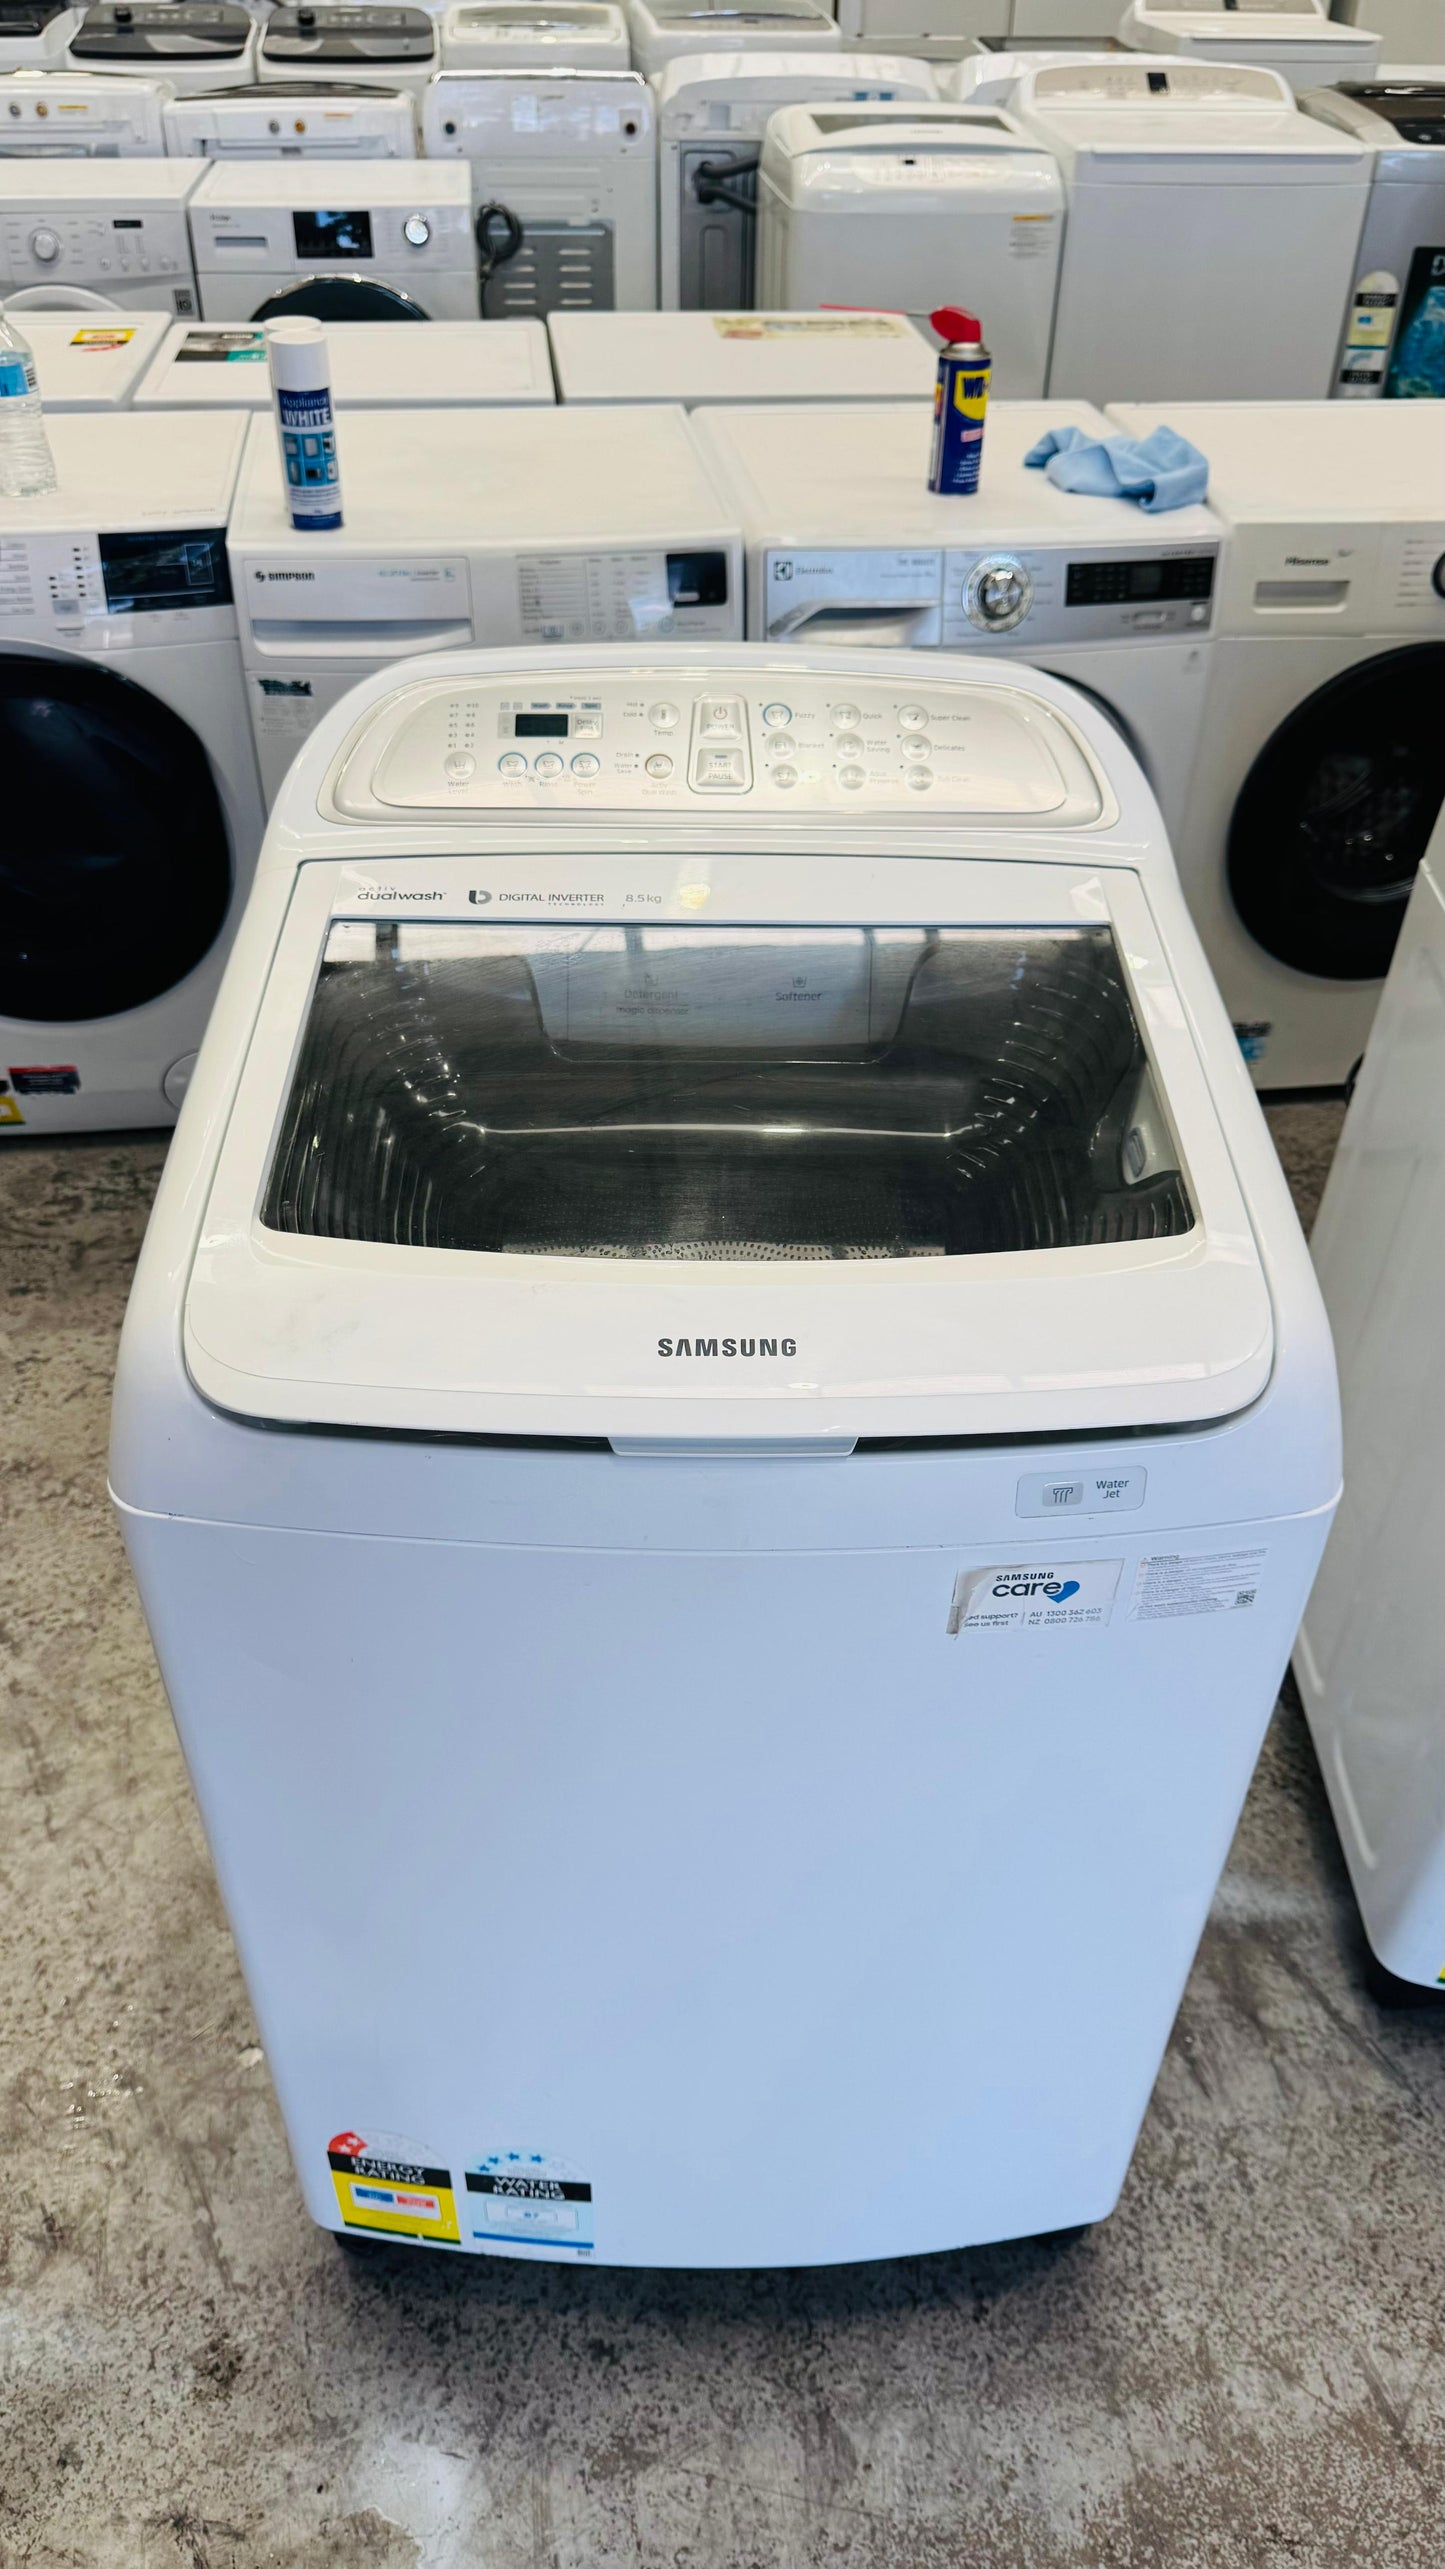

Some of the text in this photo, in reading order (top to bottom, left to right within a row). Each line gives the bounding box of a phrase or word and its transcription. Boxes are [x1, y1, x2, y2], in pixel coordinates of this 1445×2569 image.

[283, 408, 331, 428] WHITE
[794, 711, 816, 719] Fuzzy
[933, 744, 966, 752] Delicates
[447, 780, 470, 788] Water
[356, 889, 444, 902] dualwash
[498, 893, 606, 904] DIGITAL INVERTER
[624, 988, 679, 1002] Detergent
[775, 991, 824, 1002] Softener
[615, 1006, 646, 1017] magic
[657, 1337, 798, 1358] SAMSUNG
[1095, 1478, 1130, 1490] Water
[1101, 1487, 1121, 1500] Jet
[1150, 1553, 1181, 1562] Warning
[995, 1571, 1055, 1583] SAMSUNG
[991, 1579, 1063, 1599] care
[980, 1612, 1019, 1621] support?
[1085, 1607, 1103, 1615] 603
[1043, 1617, 1067, 1625] 0800
[350, 2156, 426, 2176] ENERGY
[353, 2165, 427, 2186] RATING
[494, 2175, 561, 2192] WATER
[492, 2183, 567, 2202] RATING
